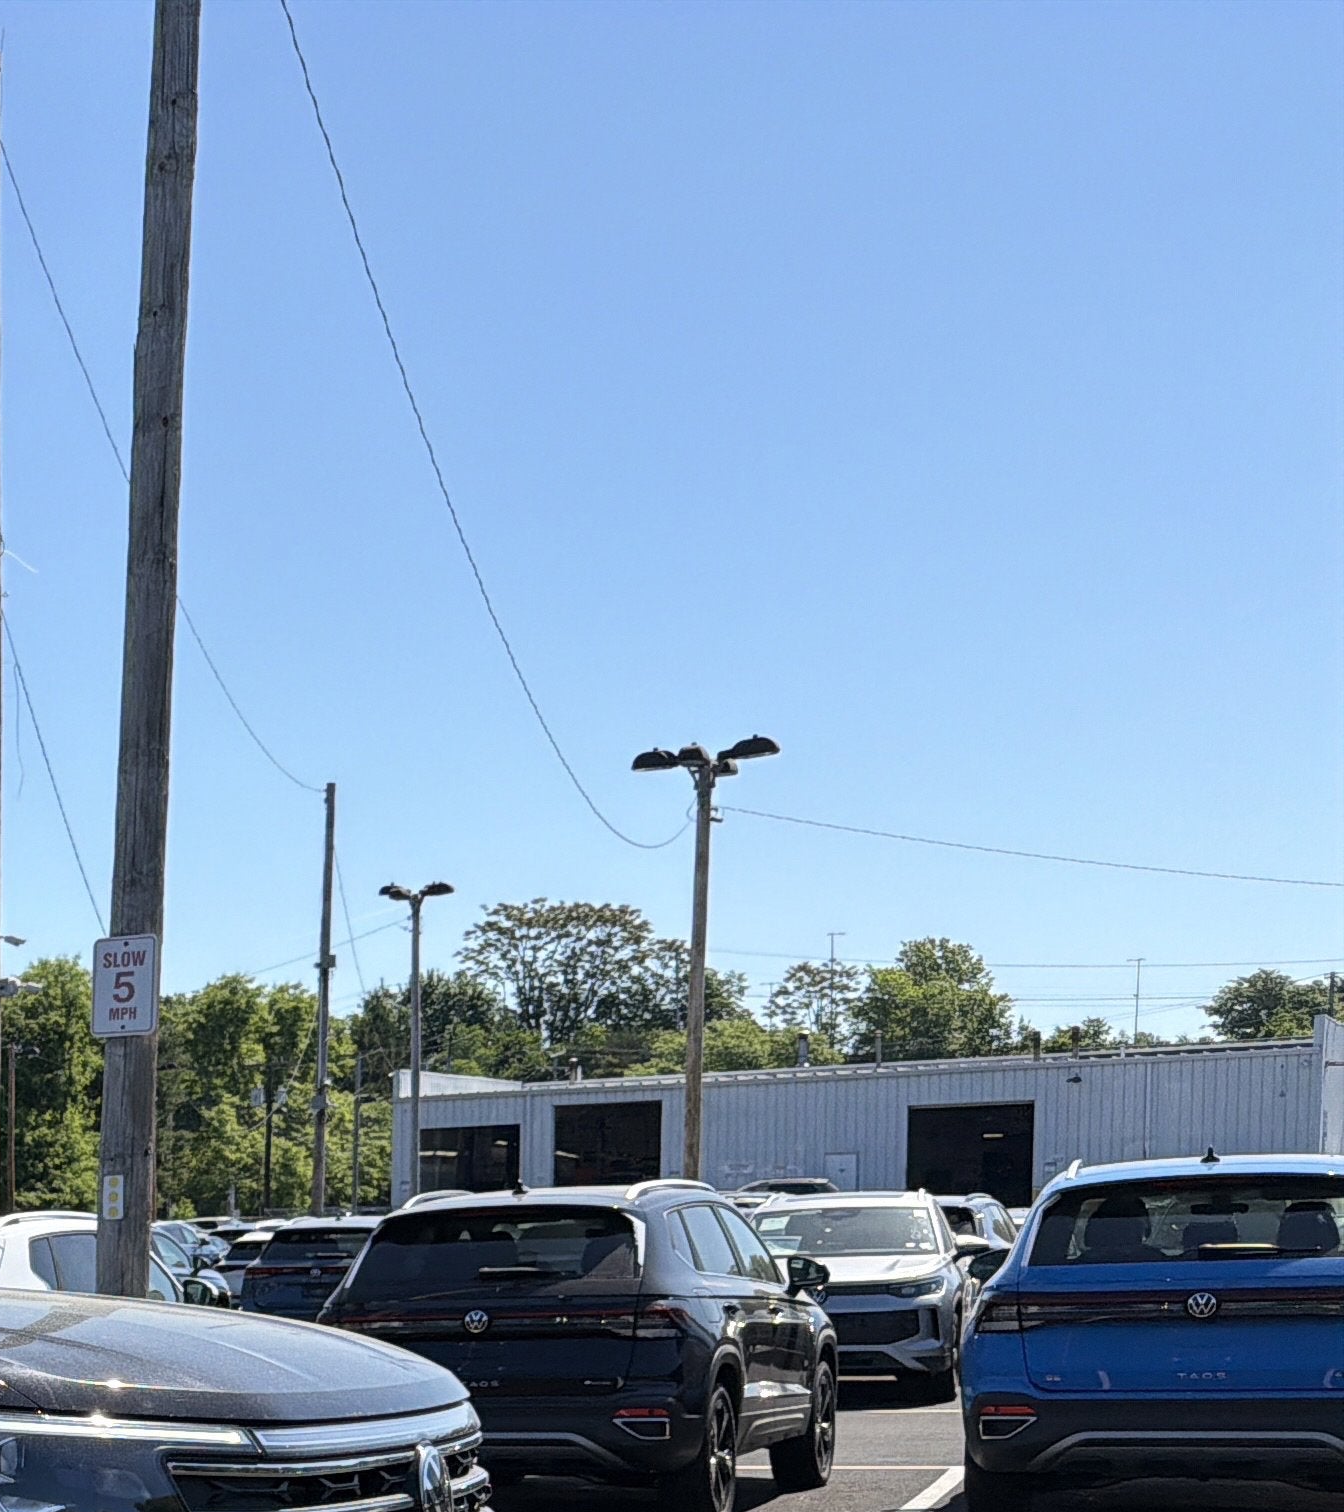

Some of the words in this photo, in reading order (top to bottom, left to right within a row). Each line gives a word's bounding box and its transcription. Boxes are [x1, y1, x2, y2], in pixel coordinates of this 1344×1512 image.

[103, 950, 147, 969] SLOW
[112, 971, 136, 1003] 5
[108, 1007, 138, 1021] MPH
[1187, 1292, 1217, 1318] VW
[464, 1309, 489, 1334] VW
[1176, 1372, 1227, 1380] TAOS
